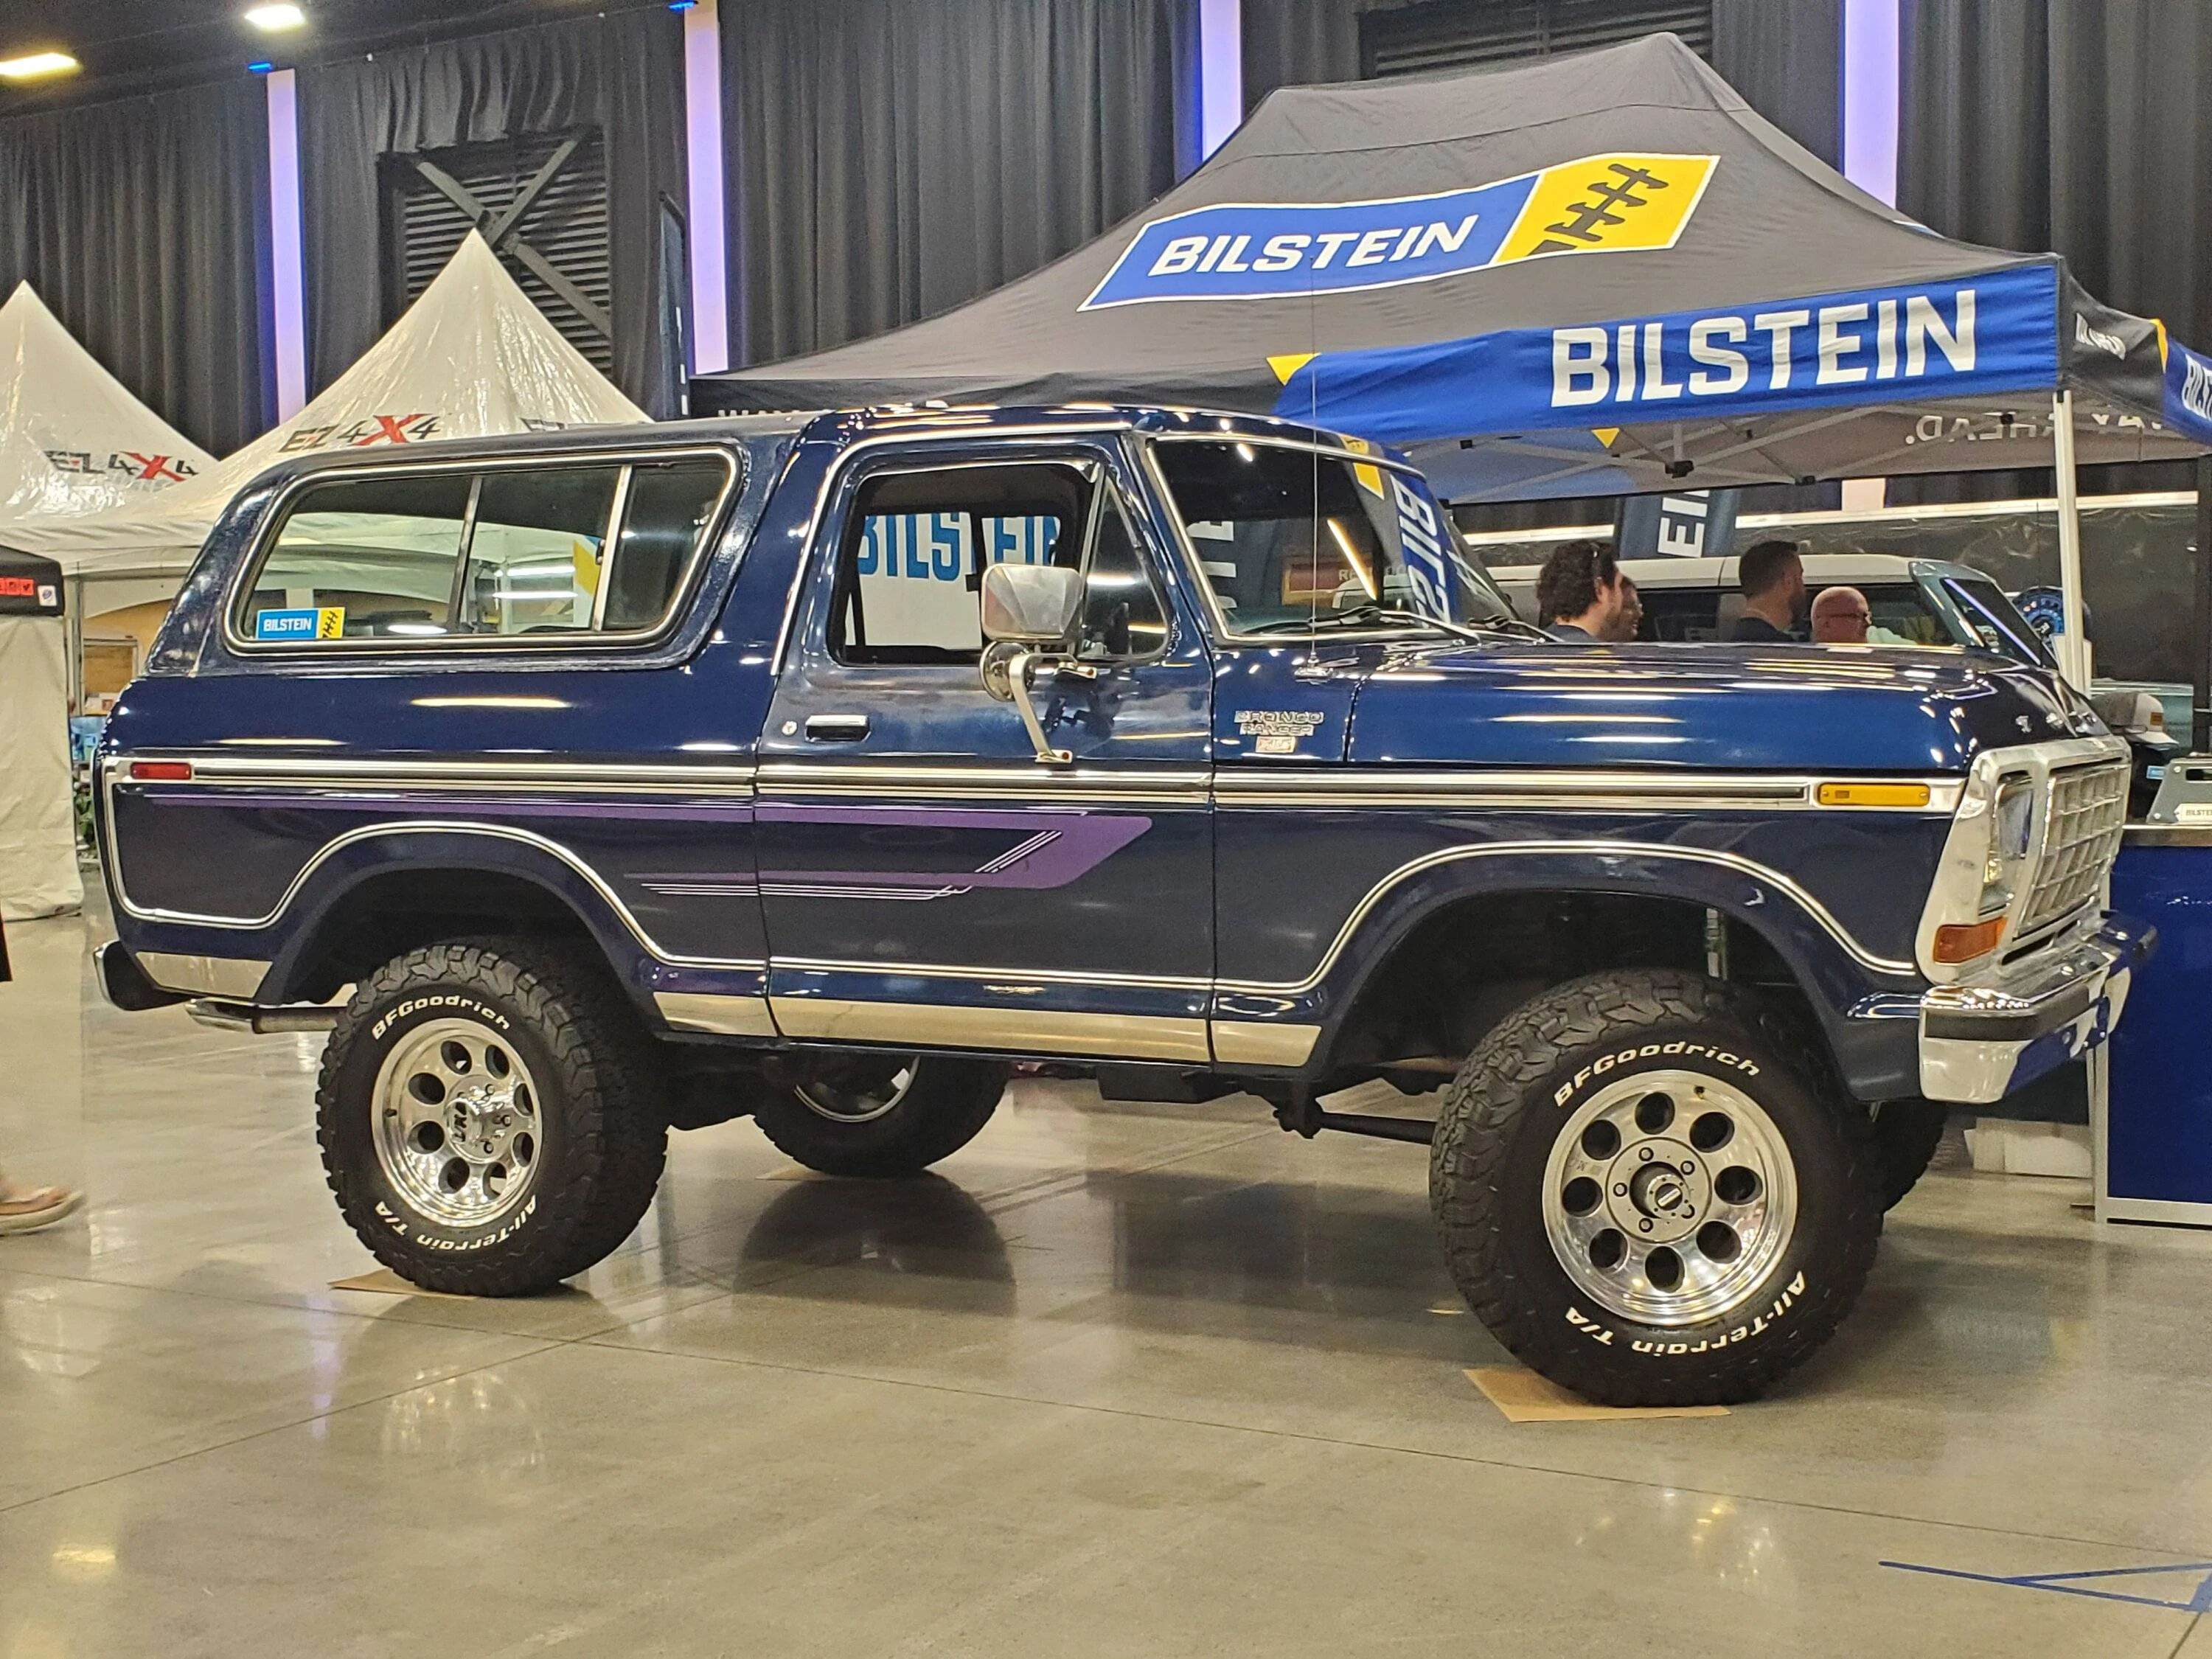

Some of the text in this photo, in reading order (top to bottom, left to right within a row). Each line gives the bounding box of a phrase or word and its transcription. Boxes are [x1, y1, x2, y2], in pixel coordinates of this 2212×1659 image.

[1148, 214, 1479, 277] BILSTEIN
[1551, 289, 1977, 408] BILSTEIN
[263, 617, 312, 632] BILSTEIN
[1234, 710, 1324, 725] BRONCO
[372, 995, 510, 1040] BFGoodrich
[1554, 1041, 1761, 1108] BFGoodrich
[374, 1194, 538, 1251] All-Terrain T/A
[1565, 1270, 1806, 1357] All-Terrain T/A
